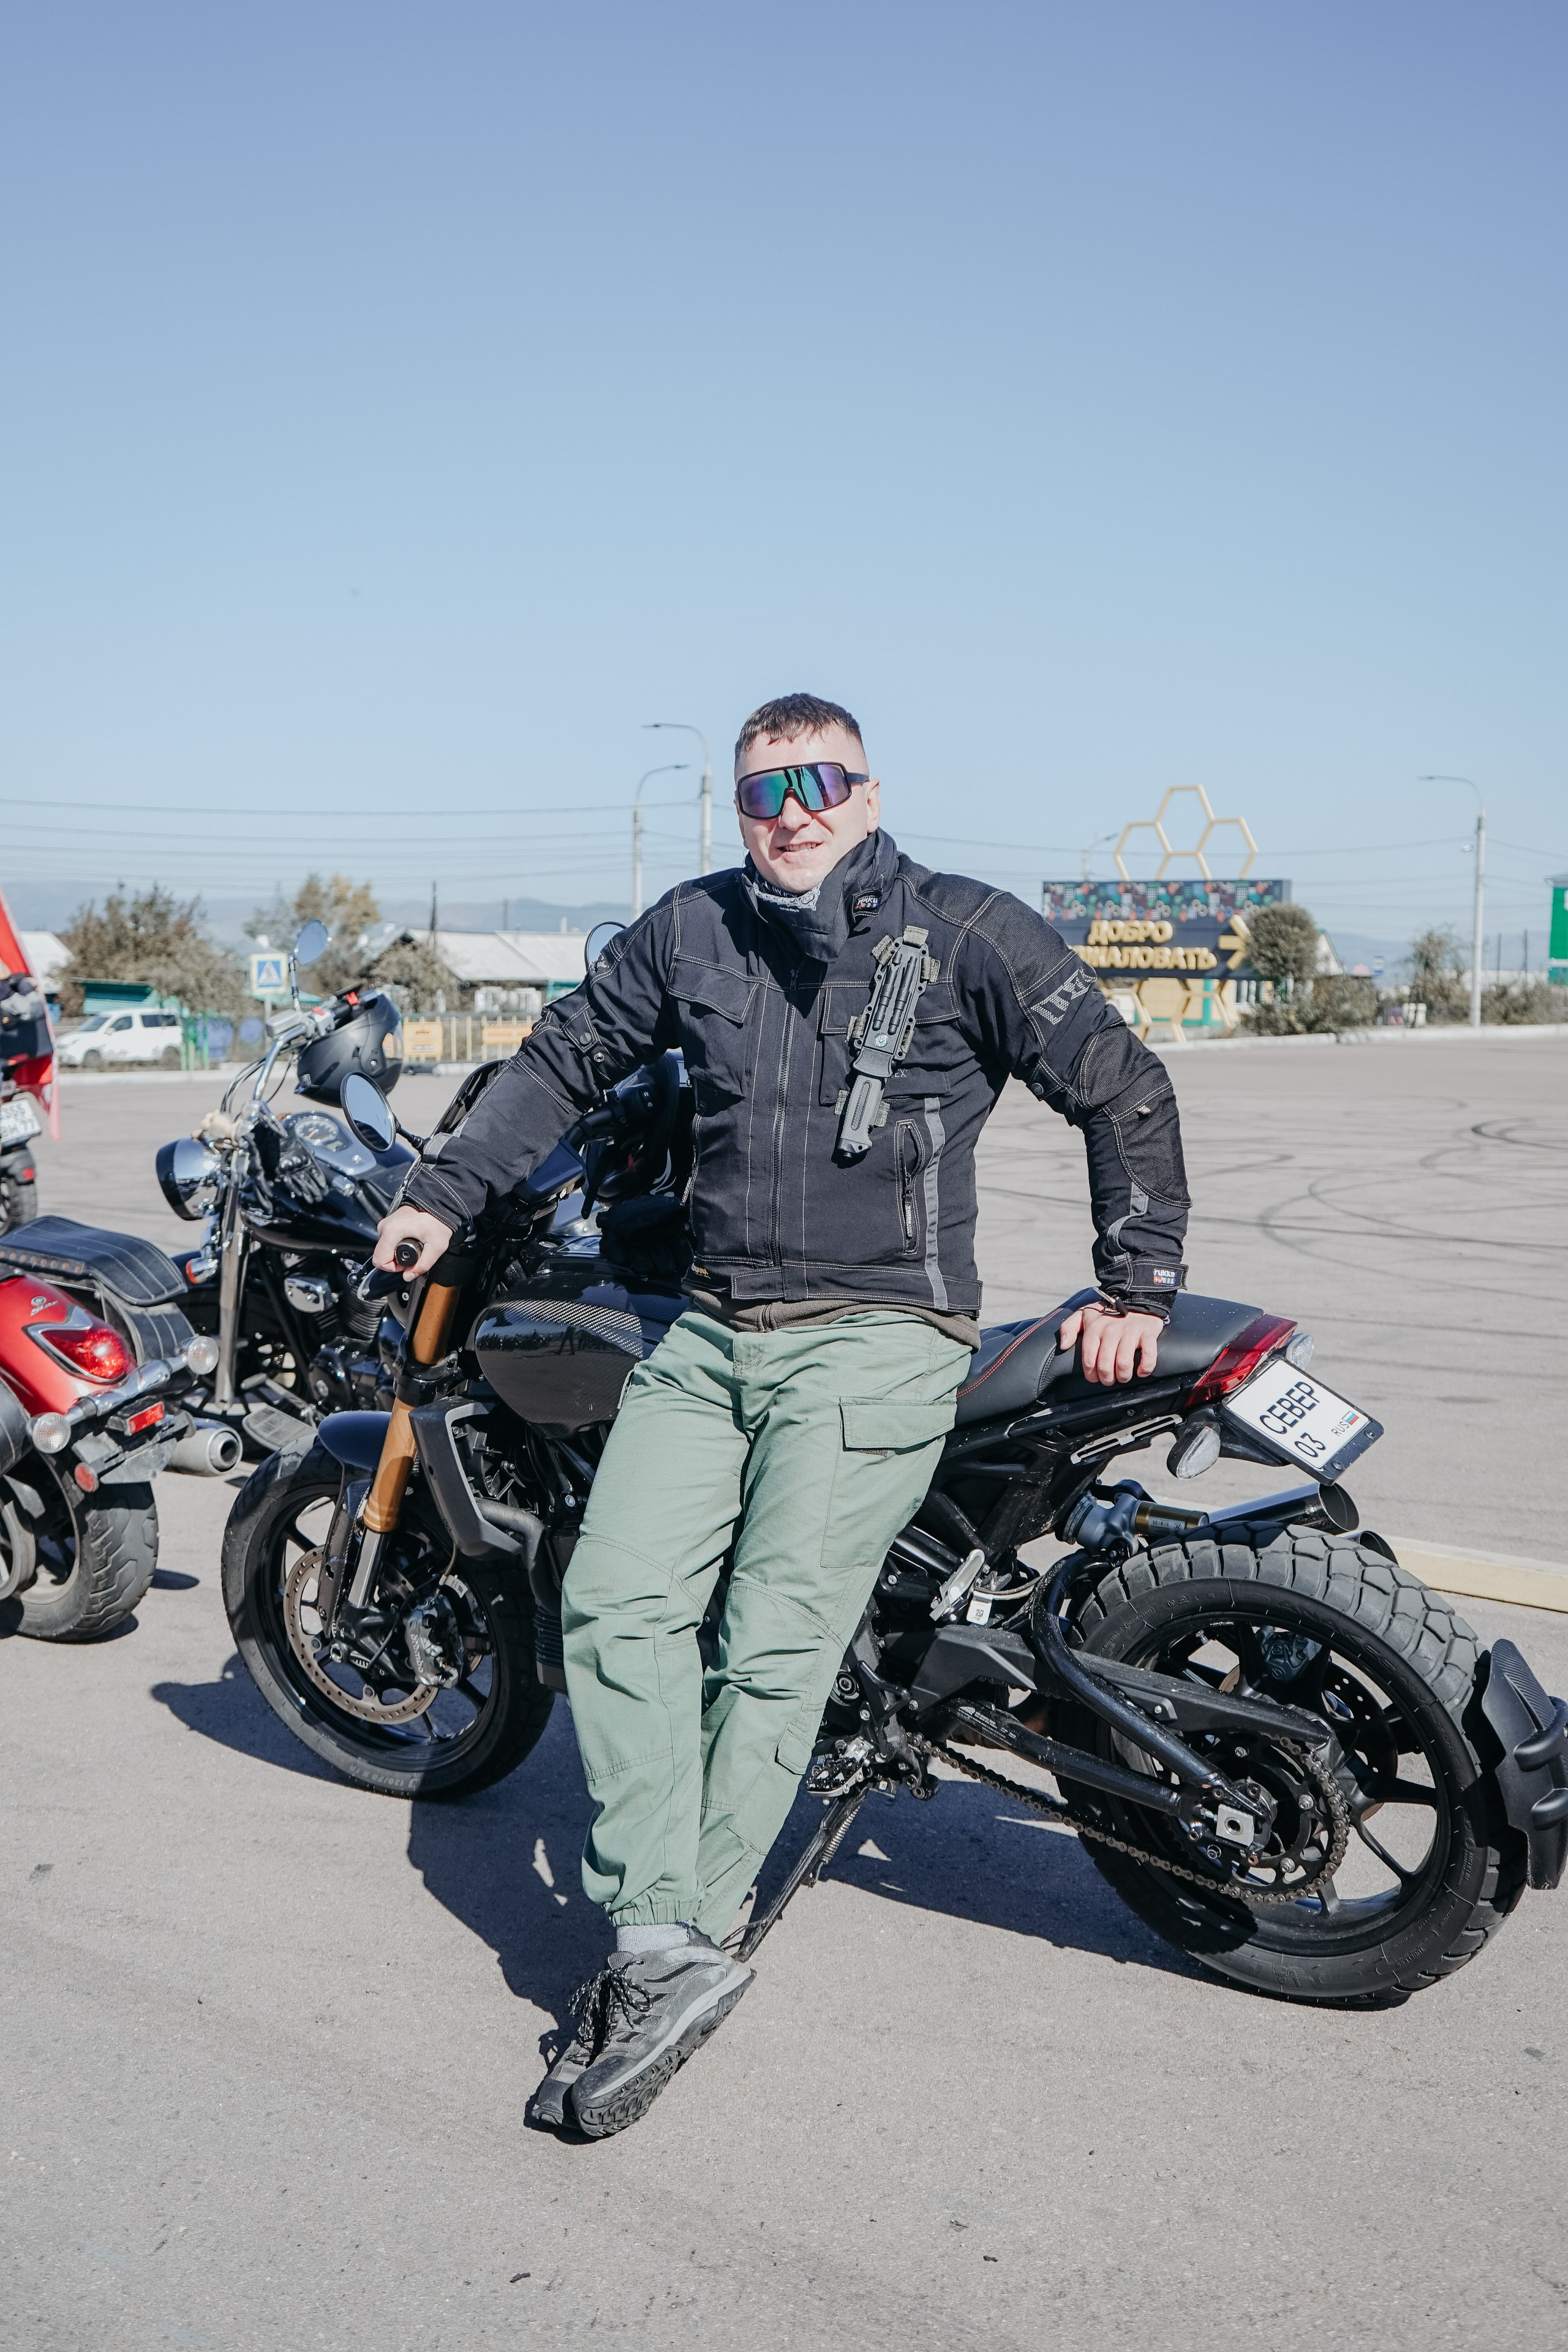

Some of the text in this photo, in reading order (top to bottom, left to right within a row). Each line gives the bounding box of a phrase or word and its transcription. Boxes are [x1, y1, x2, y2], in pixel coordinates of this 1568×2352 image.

[1087, 920, 1174, 945] ДОБРО
[1068, 945, 1218, 970] ОЖАЛОВАТЬ
[1154, 1269, 1175, 1278] rukka
[1260, 1381, 1320, 1434] СЕВЕР
[1331, 1420, 1349, 1436] RUS
[1294, 1432, 1326, 1458] 03
[410, 1634, 424, 1673] brembo
[371, 1773, 404, 1787] 120/70
